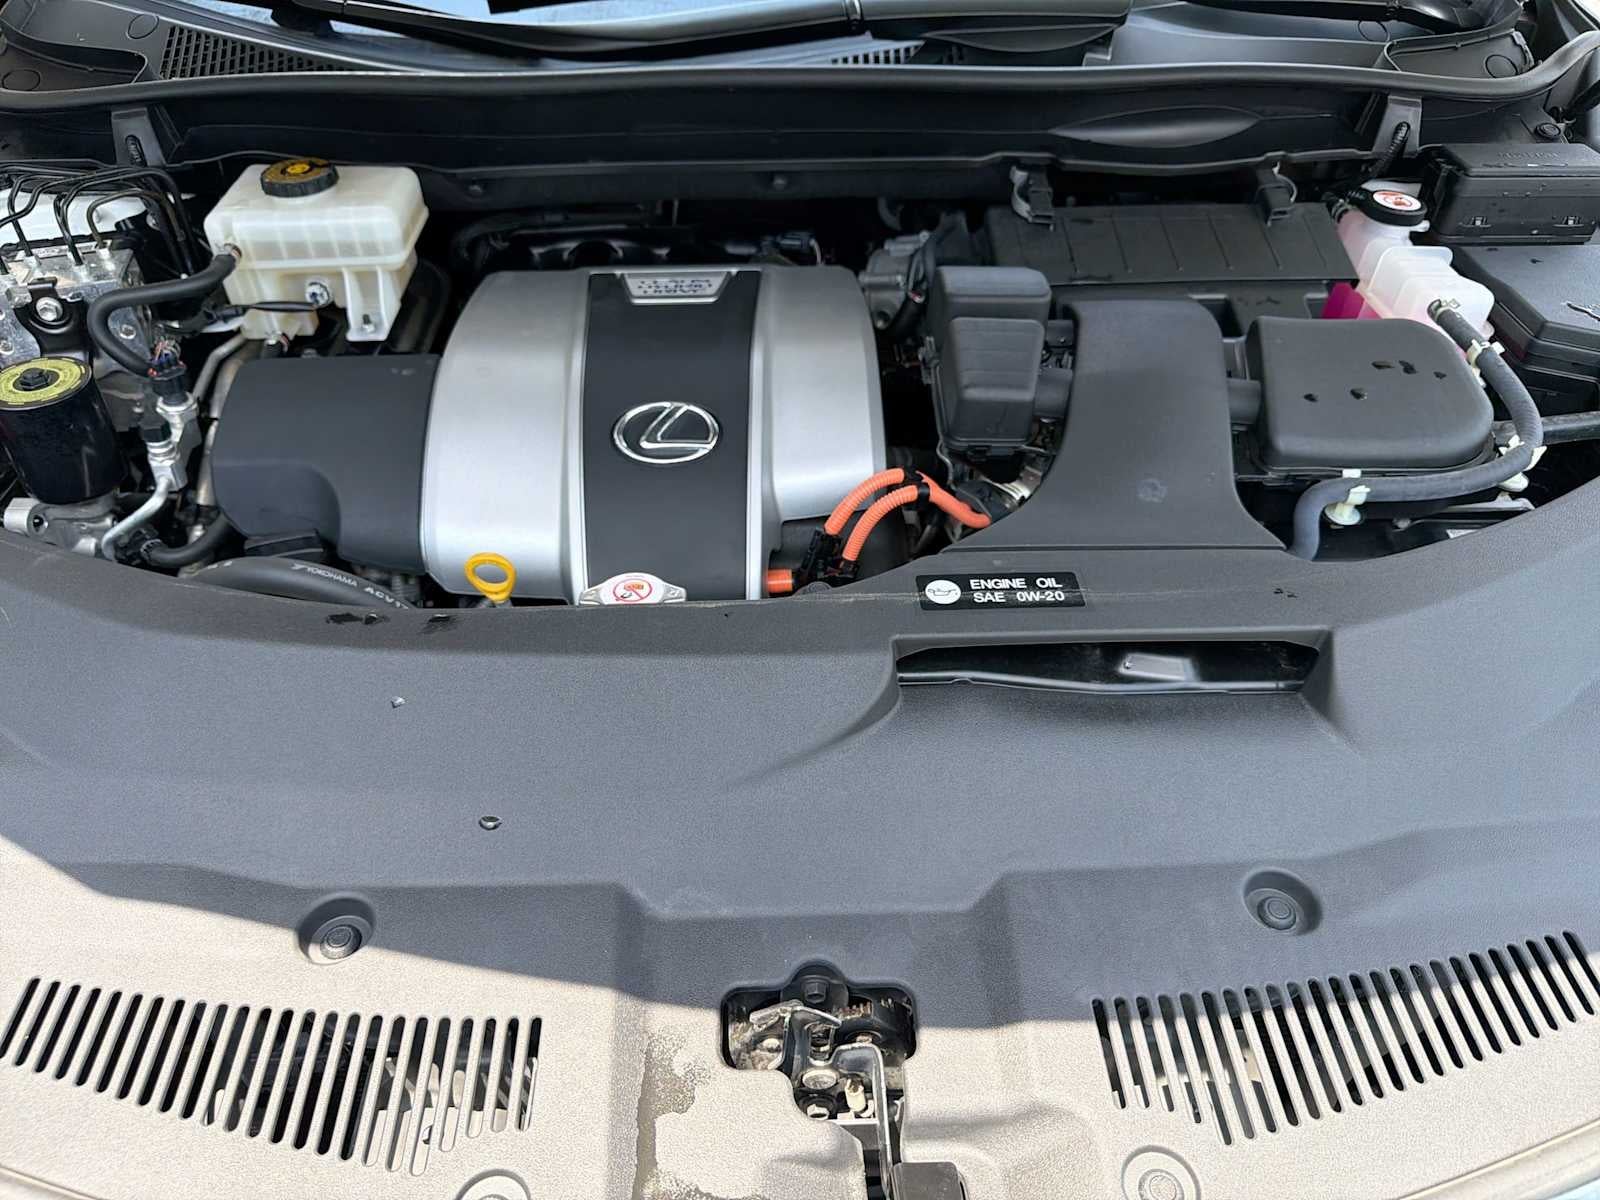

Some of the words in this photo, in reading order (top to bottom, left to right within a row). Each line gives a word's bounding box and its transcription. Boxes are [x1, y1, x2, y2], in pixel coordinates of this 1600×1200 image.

[306, 566, 358, 588] YOKOHAMA
[970, 578, 1027, 590] ENGINE
[1036, 577, 1063, 589] OIL
[973, 591, 1006, 603] SAE
[1016, 590, 1065, 602] 0W-20
